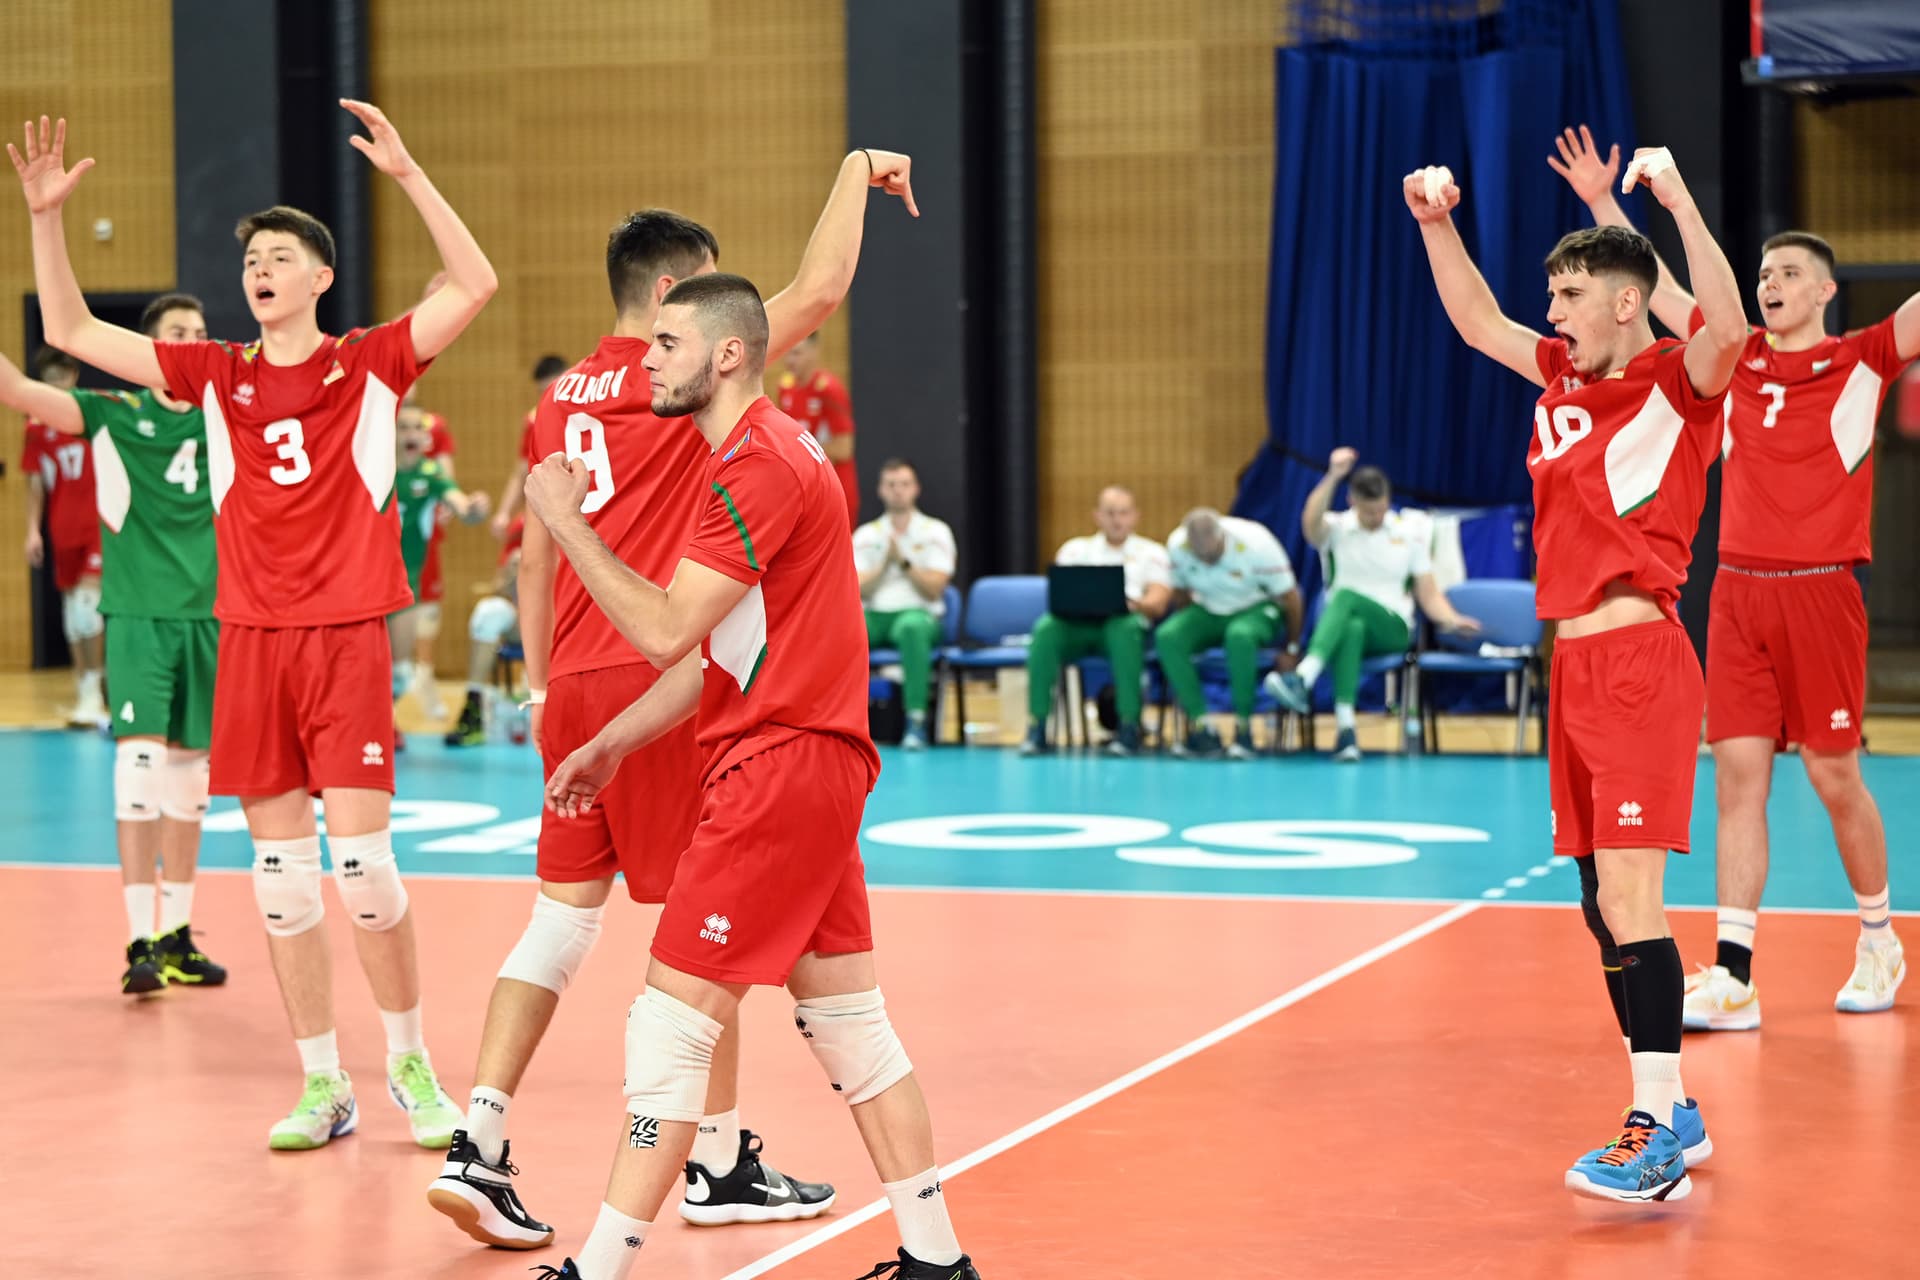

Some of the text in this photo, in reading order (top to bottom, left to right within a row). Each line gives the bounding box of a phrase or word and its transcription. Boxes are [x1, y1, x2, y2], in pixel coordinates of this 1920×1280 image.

[1757, 382, 1786, 429] 7
[56, 442, 85, 480] 17
[164, 438, 199, 494] 4
[263, 417, 311, 486] 3
[565, 412, 615, 514] 9
[119, 700, 134, 724] 4
[699, 928, 728, 945] errea
